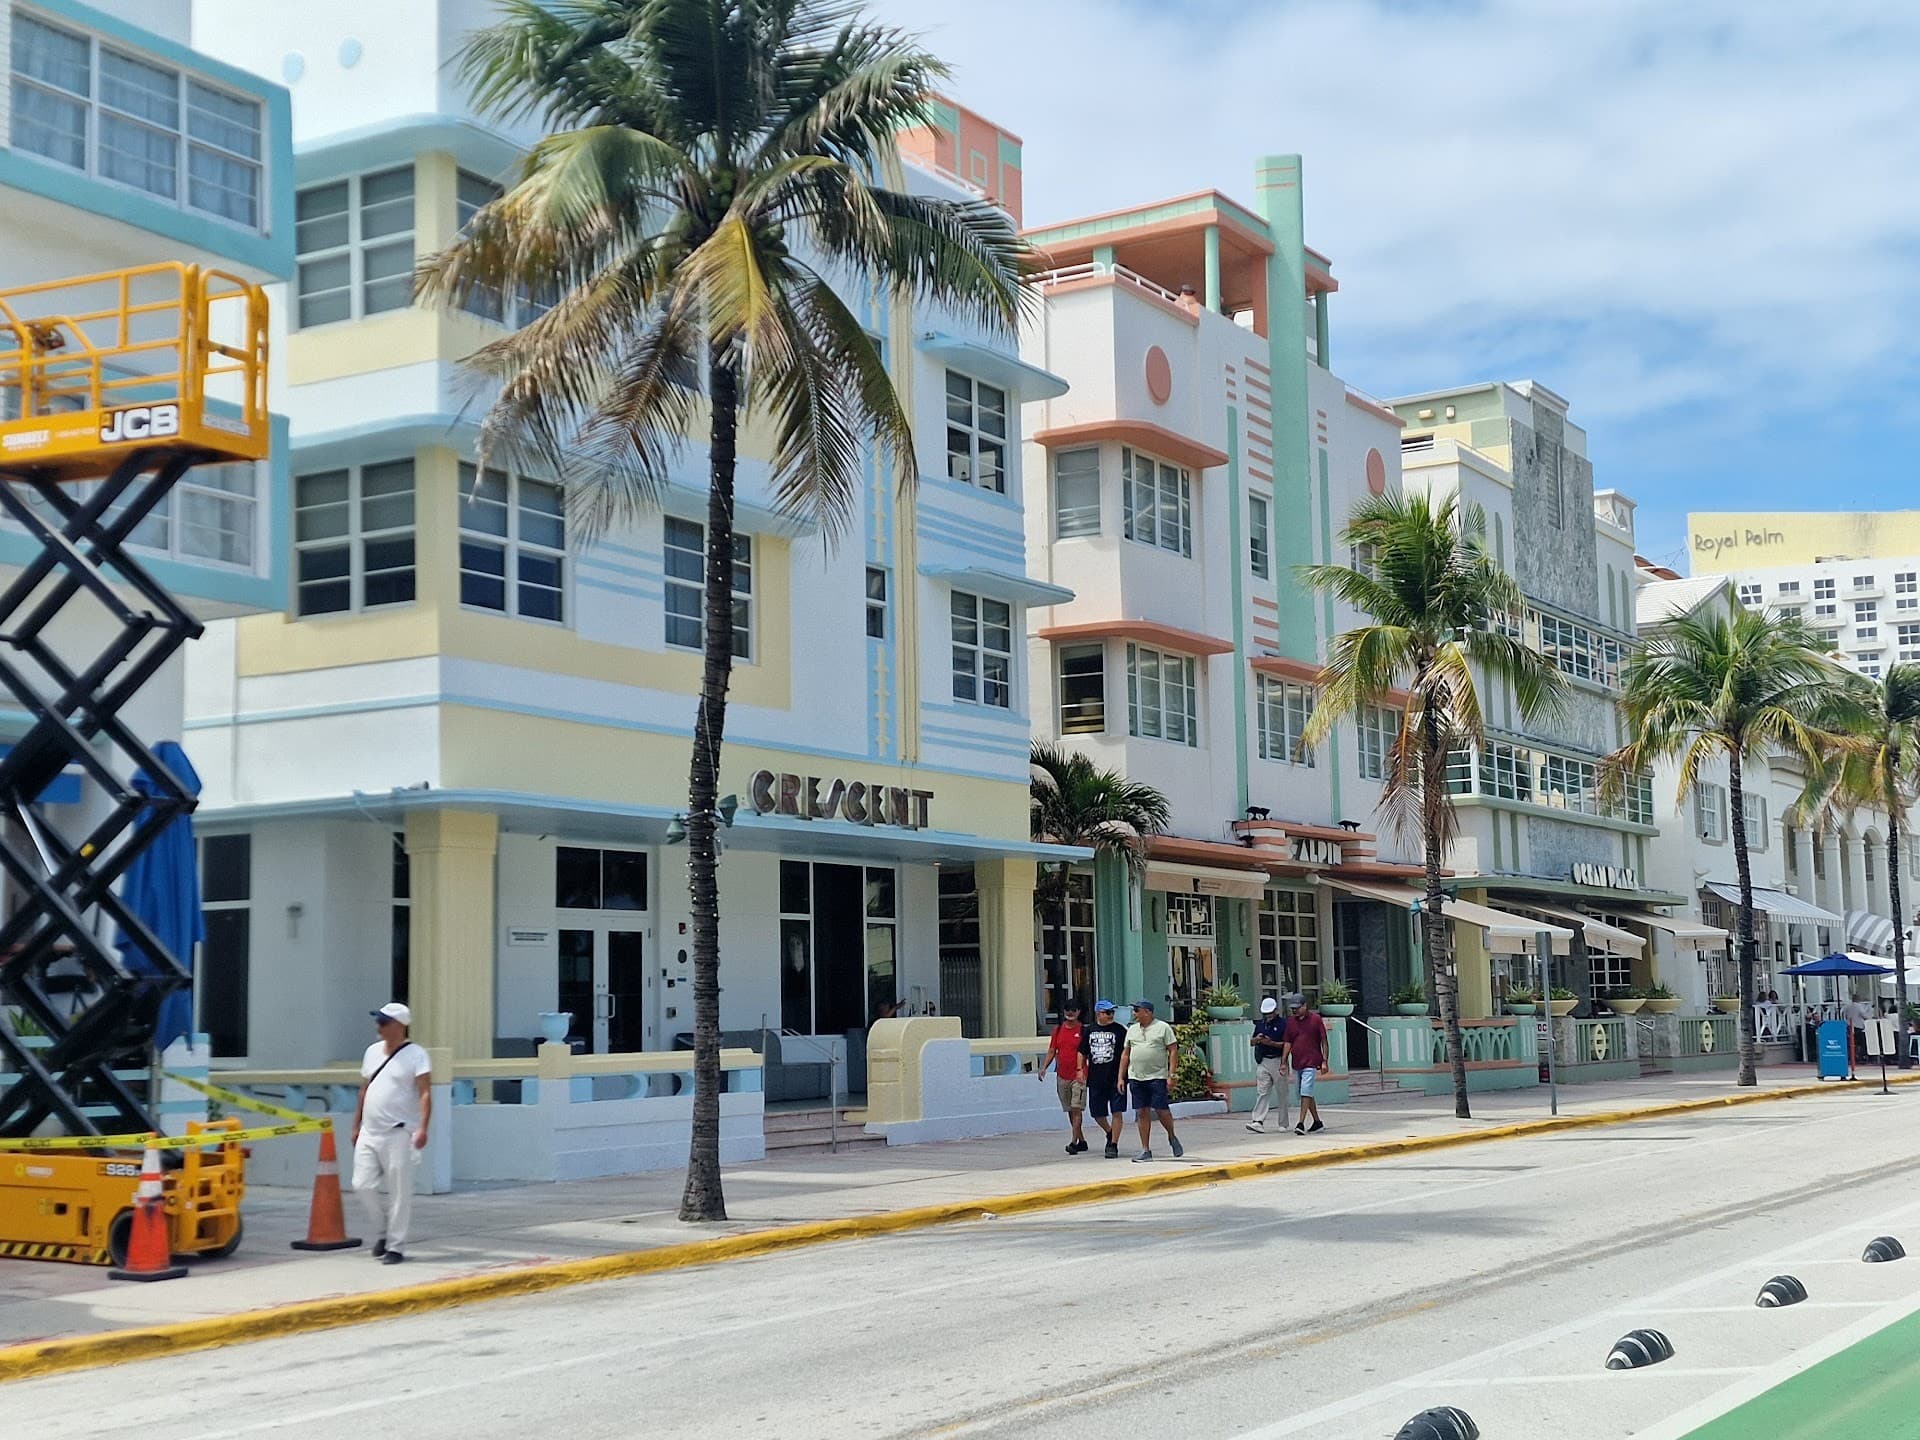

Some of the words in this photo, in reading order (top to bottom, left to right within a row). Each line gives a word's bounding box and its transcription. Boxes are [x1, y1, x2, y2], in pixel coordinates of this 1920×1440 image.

[101, 405, 179, 442] JCB
[1694, 529, 1738, 560] Royal
[1745, 528, 1784, 546] Palm
[749, 769, 935, 829] CRESCENT
[1573, 862, 1608, 887] OCEAN
